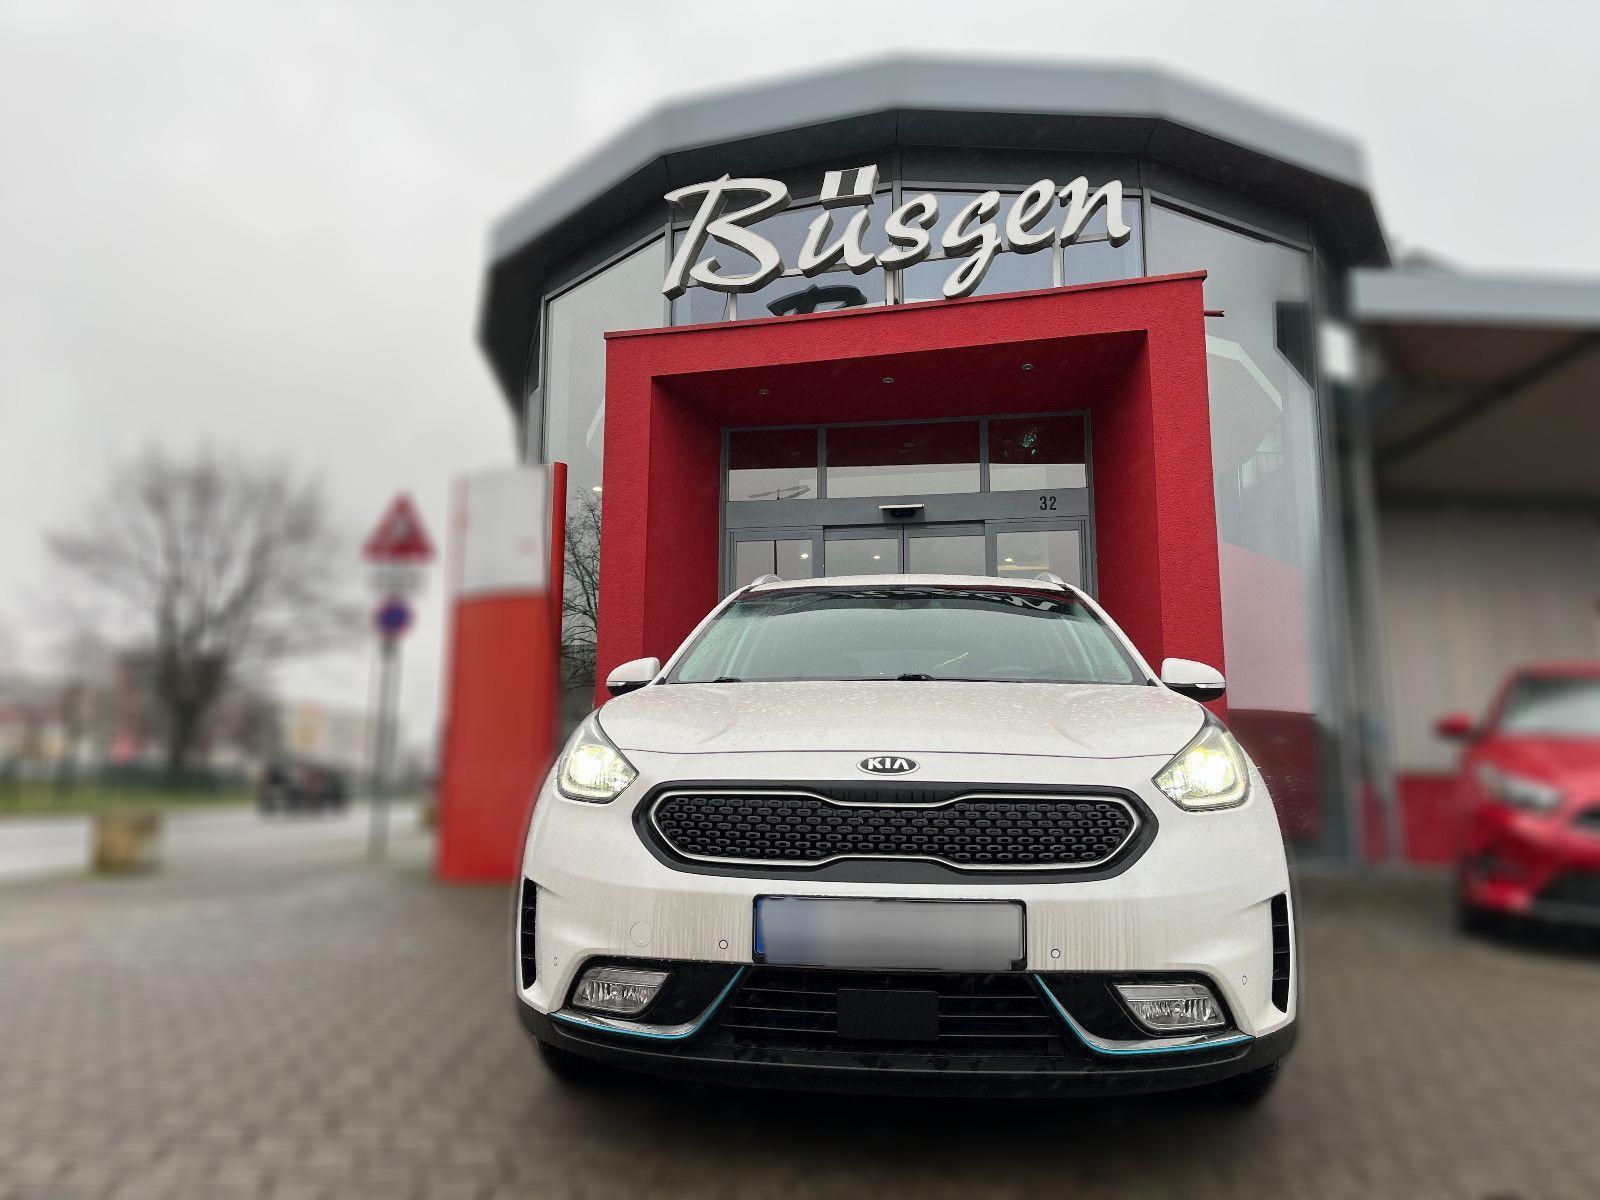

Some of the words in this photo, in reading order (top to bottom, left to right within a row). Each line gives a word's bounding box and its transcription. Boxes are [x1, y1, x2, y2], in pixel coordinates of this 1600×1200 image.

[661, 164, 1132, 300] Büsgen
[1039, 496, 1057, 511] 32
[867, 757, 910, 770] KIA
